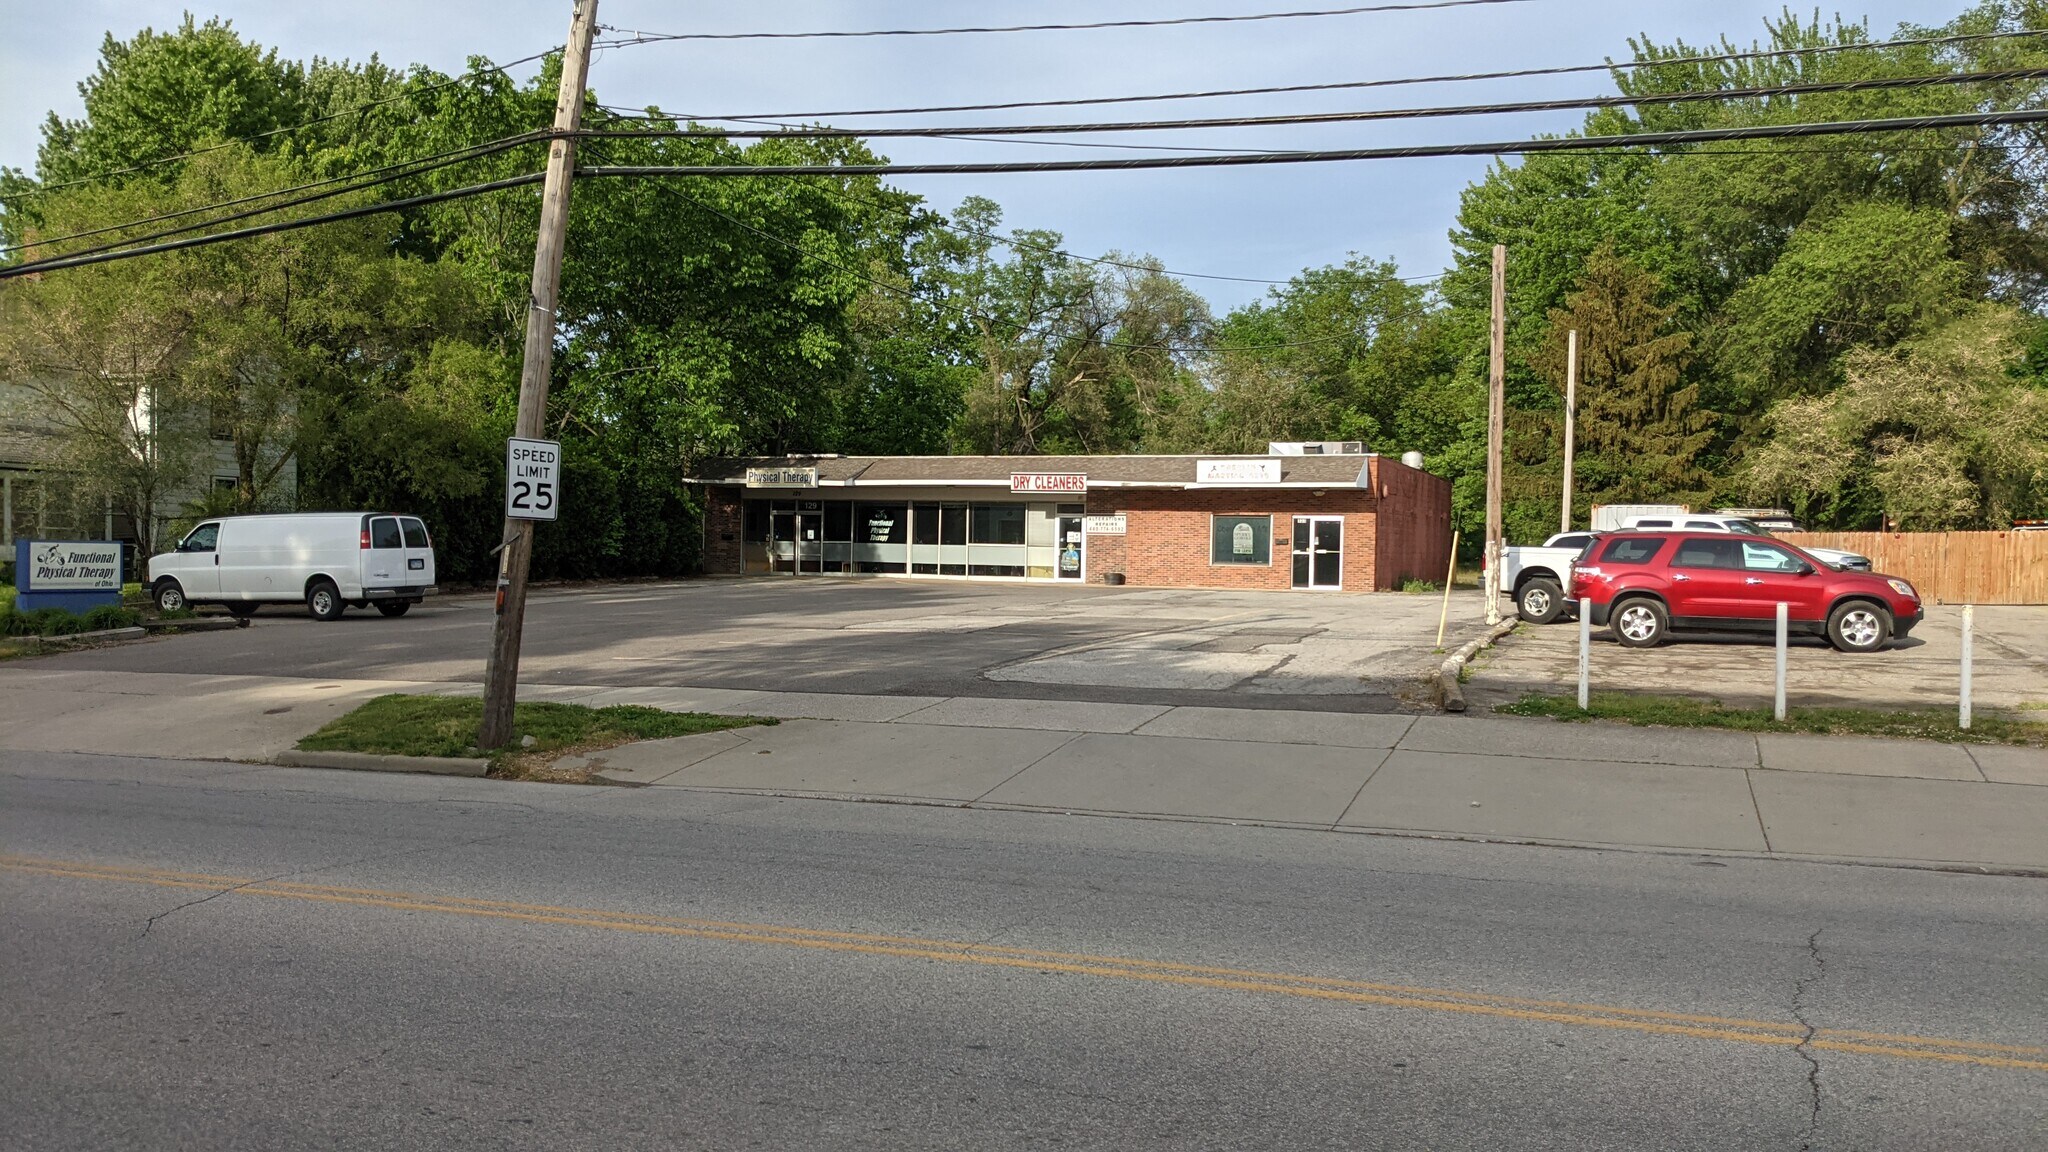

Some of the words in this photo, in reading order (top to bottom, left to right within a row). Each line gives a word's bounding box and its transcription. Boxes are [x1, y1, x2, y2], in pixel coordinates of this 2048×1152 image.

[513, 448, 555, 463] SPEED
[517, 465, 550, 479] LIMIT
[748, 471, 780, 484] Physical
[782, 471, 814, 484] Therapy
[1013, 476, 1031, 489] DRY
[1035, 476, 1085, 489] CLEANERS
[512, 481, 553, 510] 25
[67, 551, 116, 564] Functional
[36, 566, 77, 579] Physical
[78, 566, 116, 579] Therapy
